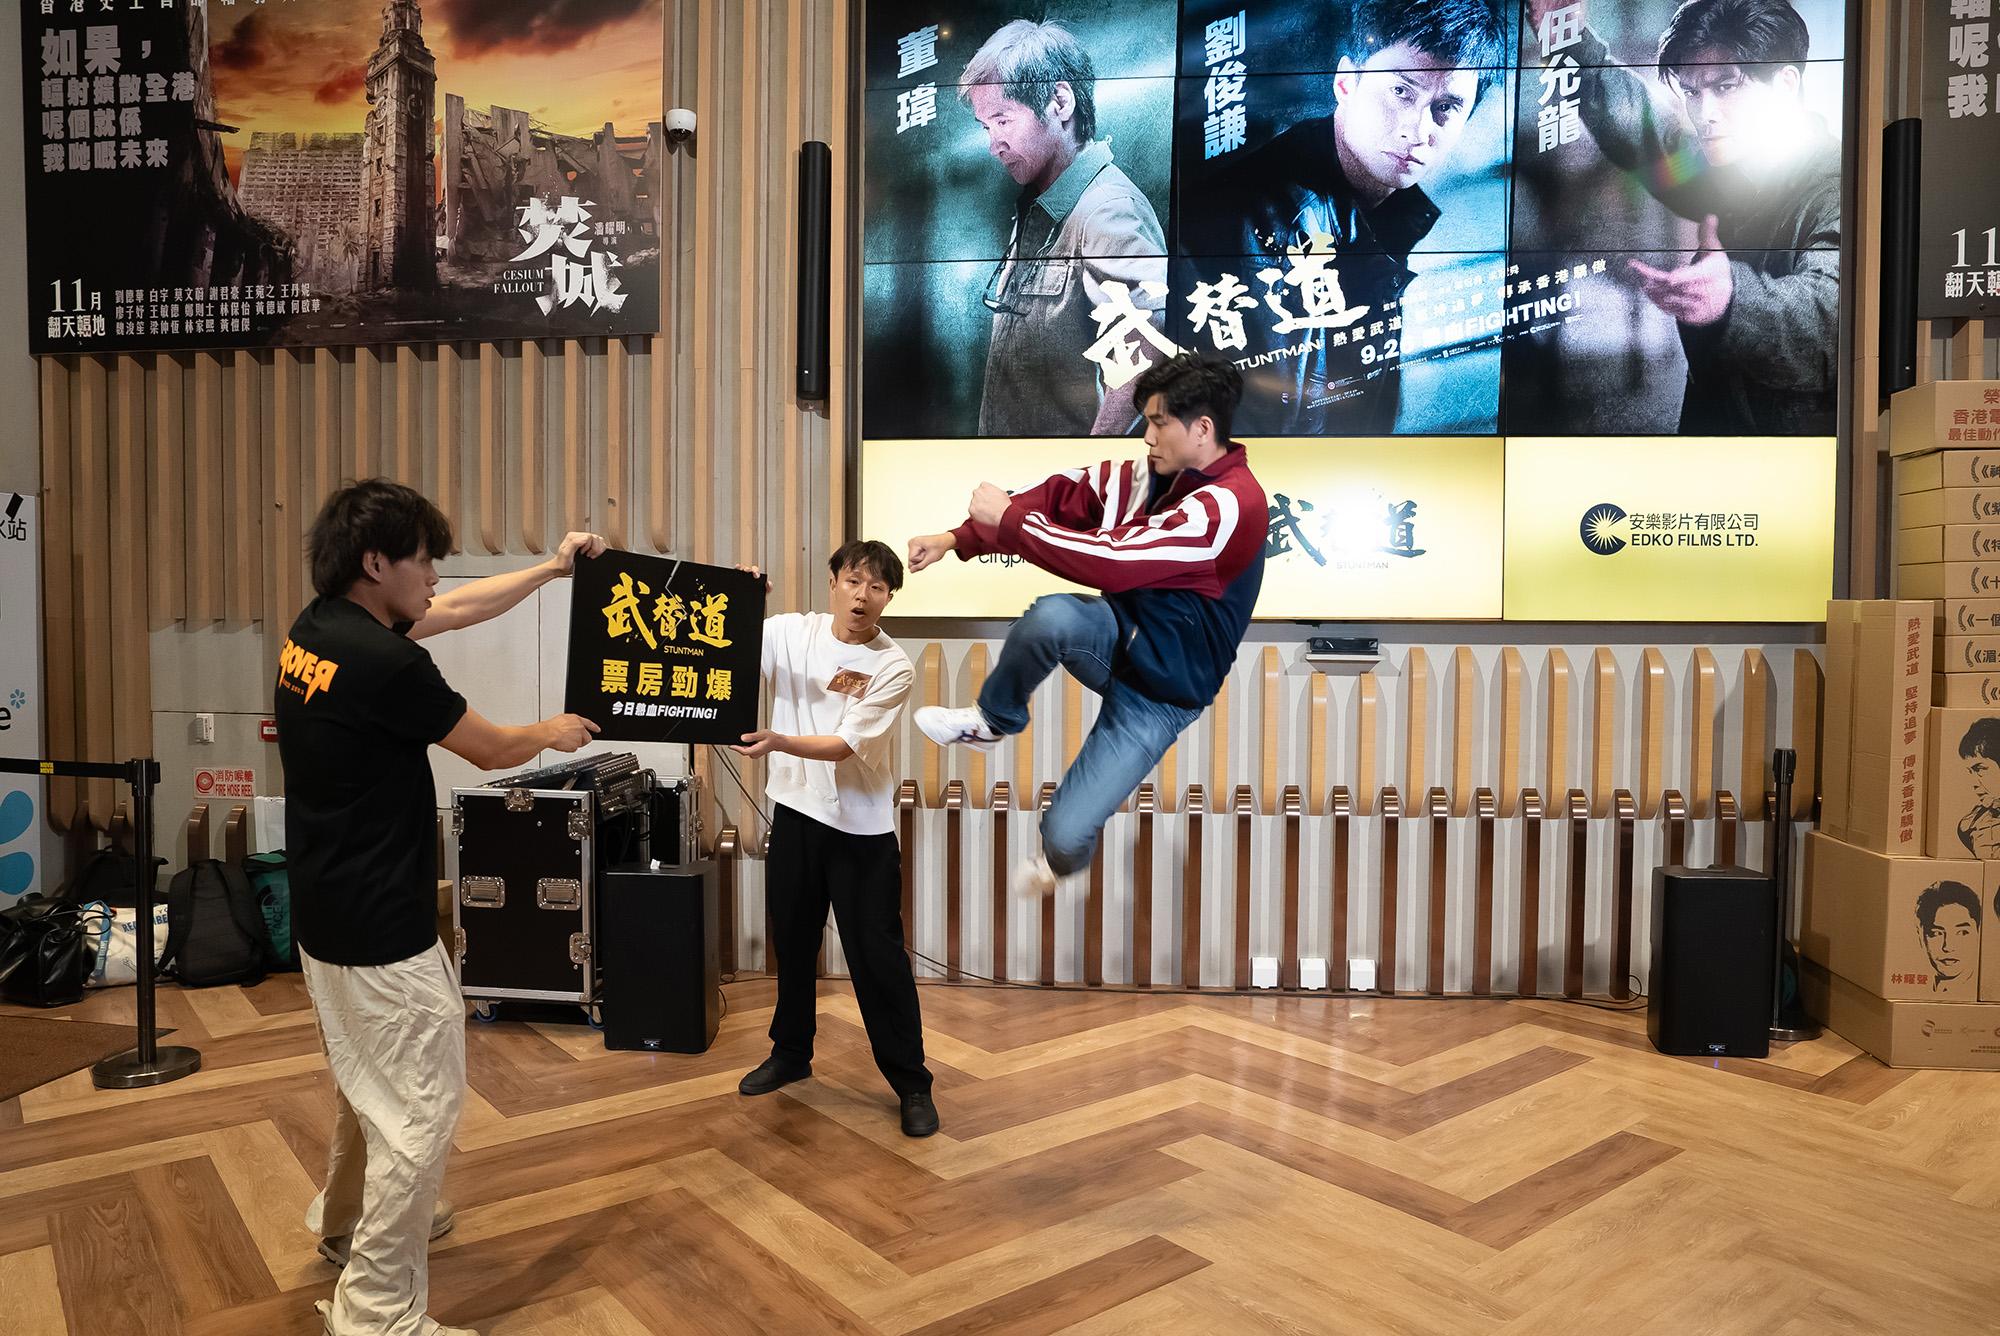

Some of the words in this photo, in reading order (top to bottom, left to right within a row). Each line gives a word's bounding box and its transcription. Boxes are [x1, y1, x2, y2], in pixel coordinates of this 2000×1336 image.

[41, 25, 152, 77] 如果，
[1949, 22, 2000, 69] 呢
[41, 71, 196, 108] 輻射擴散全港
[896, 23, 939, 135] 董瑋
[1203, 10, 1248, 160] 劉俊謙
[1537, 3, 1584, 154] 伍允龍
[1948, 72, 2000, 119] 我
[41, 106, 142, 140] 呢個就係
[42, 138, 169, 173] 我哋嘅未來
[493, 281, 545, 294] FALLOUT
[502, 268, 544, 282] CESIUM
[149, 288, 169, 303] 白宇
[1233, 338, 1322, 371] TUNTMAN
[1265, 493, 1427, 568] 武道
[1629, 513, 1759, 531] 安樂影片有限公司
[1631, 533, 1673, 547] EDKO
[1678, 533, 1722, 547] FILMS
[1726, 533, 1758, 547] LTD.
[601, 571, 733, 650] 武替道
[663, 645, 704, 656] STUNTMAN
[1974, 649, 2000, 663] 《湄
[601, 659, 732, 701] 票房勁爆
